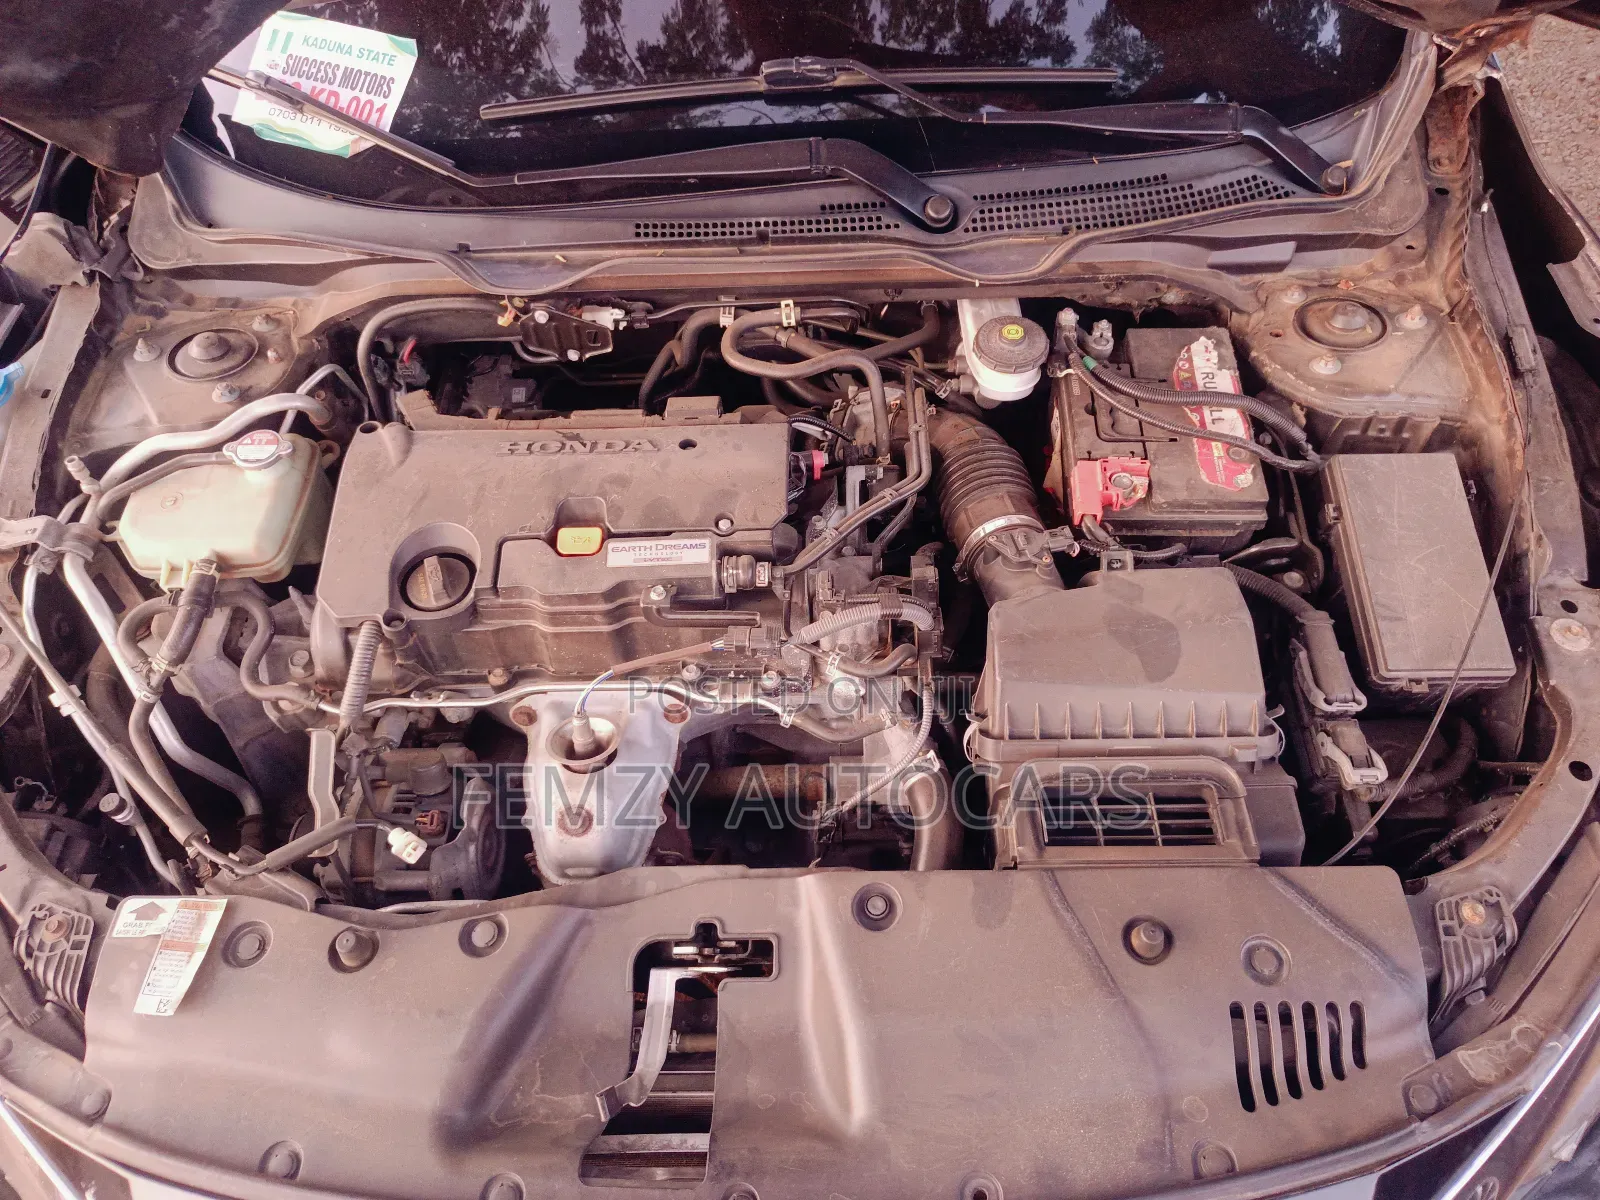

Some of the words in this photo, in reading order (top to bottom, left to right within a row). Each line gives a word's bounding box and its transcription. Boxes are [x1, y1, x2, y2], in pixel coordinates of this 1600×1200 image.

[302, 35, 353, 56] KADUNA
[356, 47, 397, 66] STATE
[281, 53, 341, 86] SUCCESS
[338, 66, 395, 99] MOTORS
[268, 107, 297, 121] 0703
[1200, 371, 1224, 426] RULL
[497, 439, 661, 456] HONDA
[611, 545, 653, 553] EARTH
[655, 542, 707, 552] DREAMS
